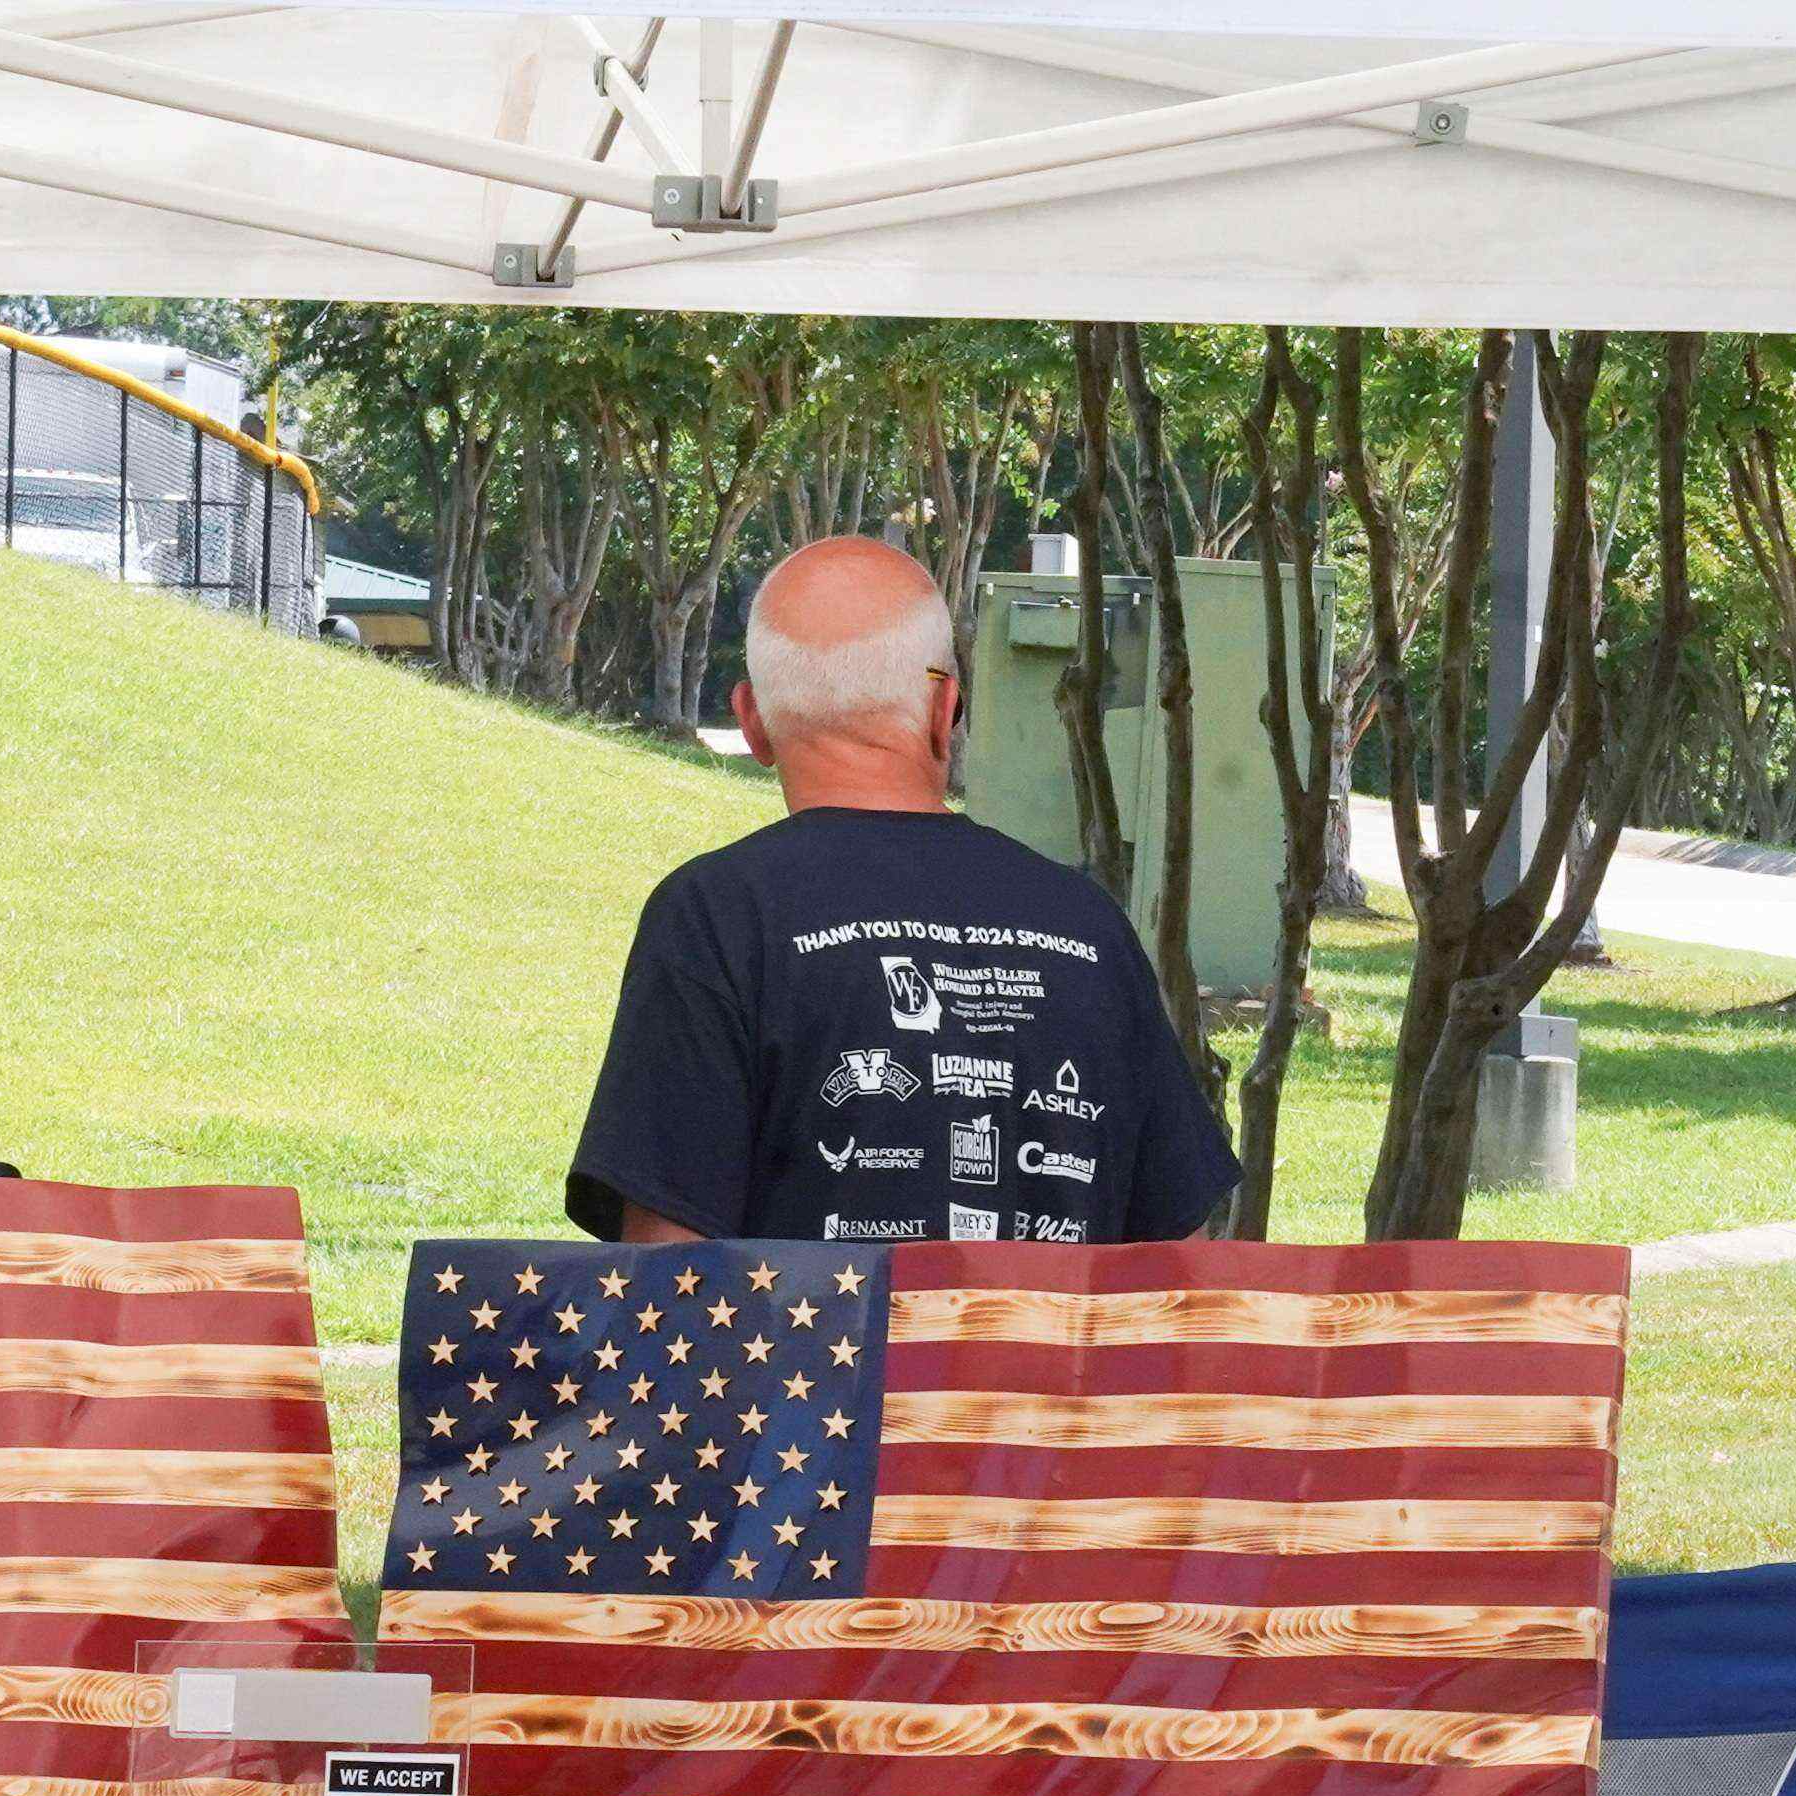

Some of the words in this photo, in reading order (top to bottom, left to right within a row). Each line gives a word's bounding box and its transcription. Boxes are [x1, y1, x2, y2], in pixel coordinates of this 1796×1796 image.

[793, 922, 863, 953] THANK
[863, 921, 901, 939] YOU
[903, 921, 927, 939] TO
[928, 923, 962, 945] OUR
[965, 927, 1014, 945] 2024
[1016, 930, 1098, 963] SPONSORS
[932, 963, 991, 981] WILLIAMS
[993, 967, 1041, 983] ELLEBY
[933, 979, 982, 996] HOWARD
[984, 984, 995, 995] &
[997, 982, 1045, 998] EASTER
[932, 1053, 1013, 1084] LUZIANNE
[827, 1066, 913, 1092] VICTORY
[958, 1080, 987, 1098] TEA
[1022, 1089, 1105, 1121] ASHLEY
[854, 1149, 879, 1159] AIR
[879, 1148, 924, 1159] FORCE
[953, 1130, 992, 1161] GEORGIA
[858, 1159, 920, 1169] RESERVE
[953, 1160, 993, 1176] grown
[1017, 1141, 1096, 1175] Casteel
[839, 1218, 926, 1237] RENASANT
[340, 1768, 369, 1786] WE
[373, 1769, 444, 1788] ACCEPT
